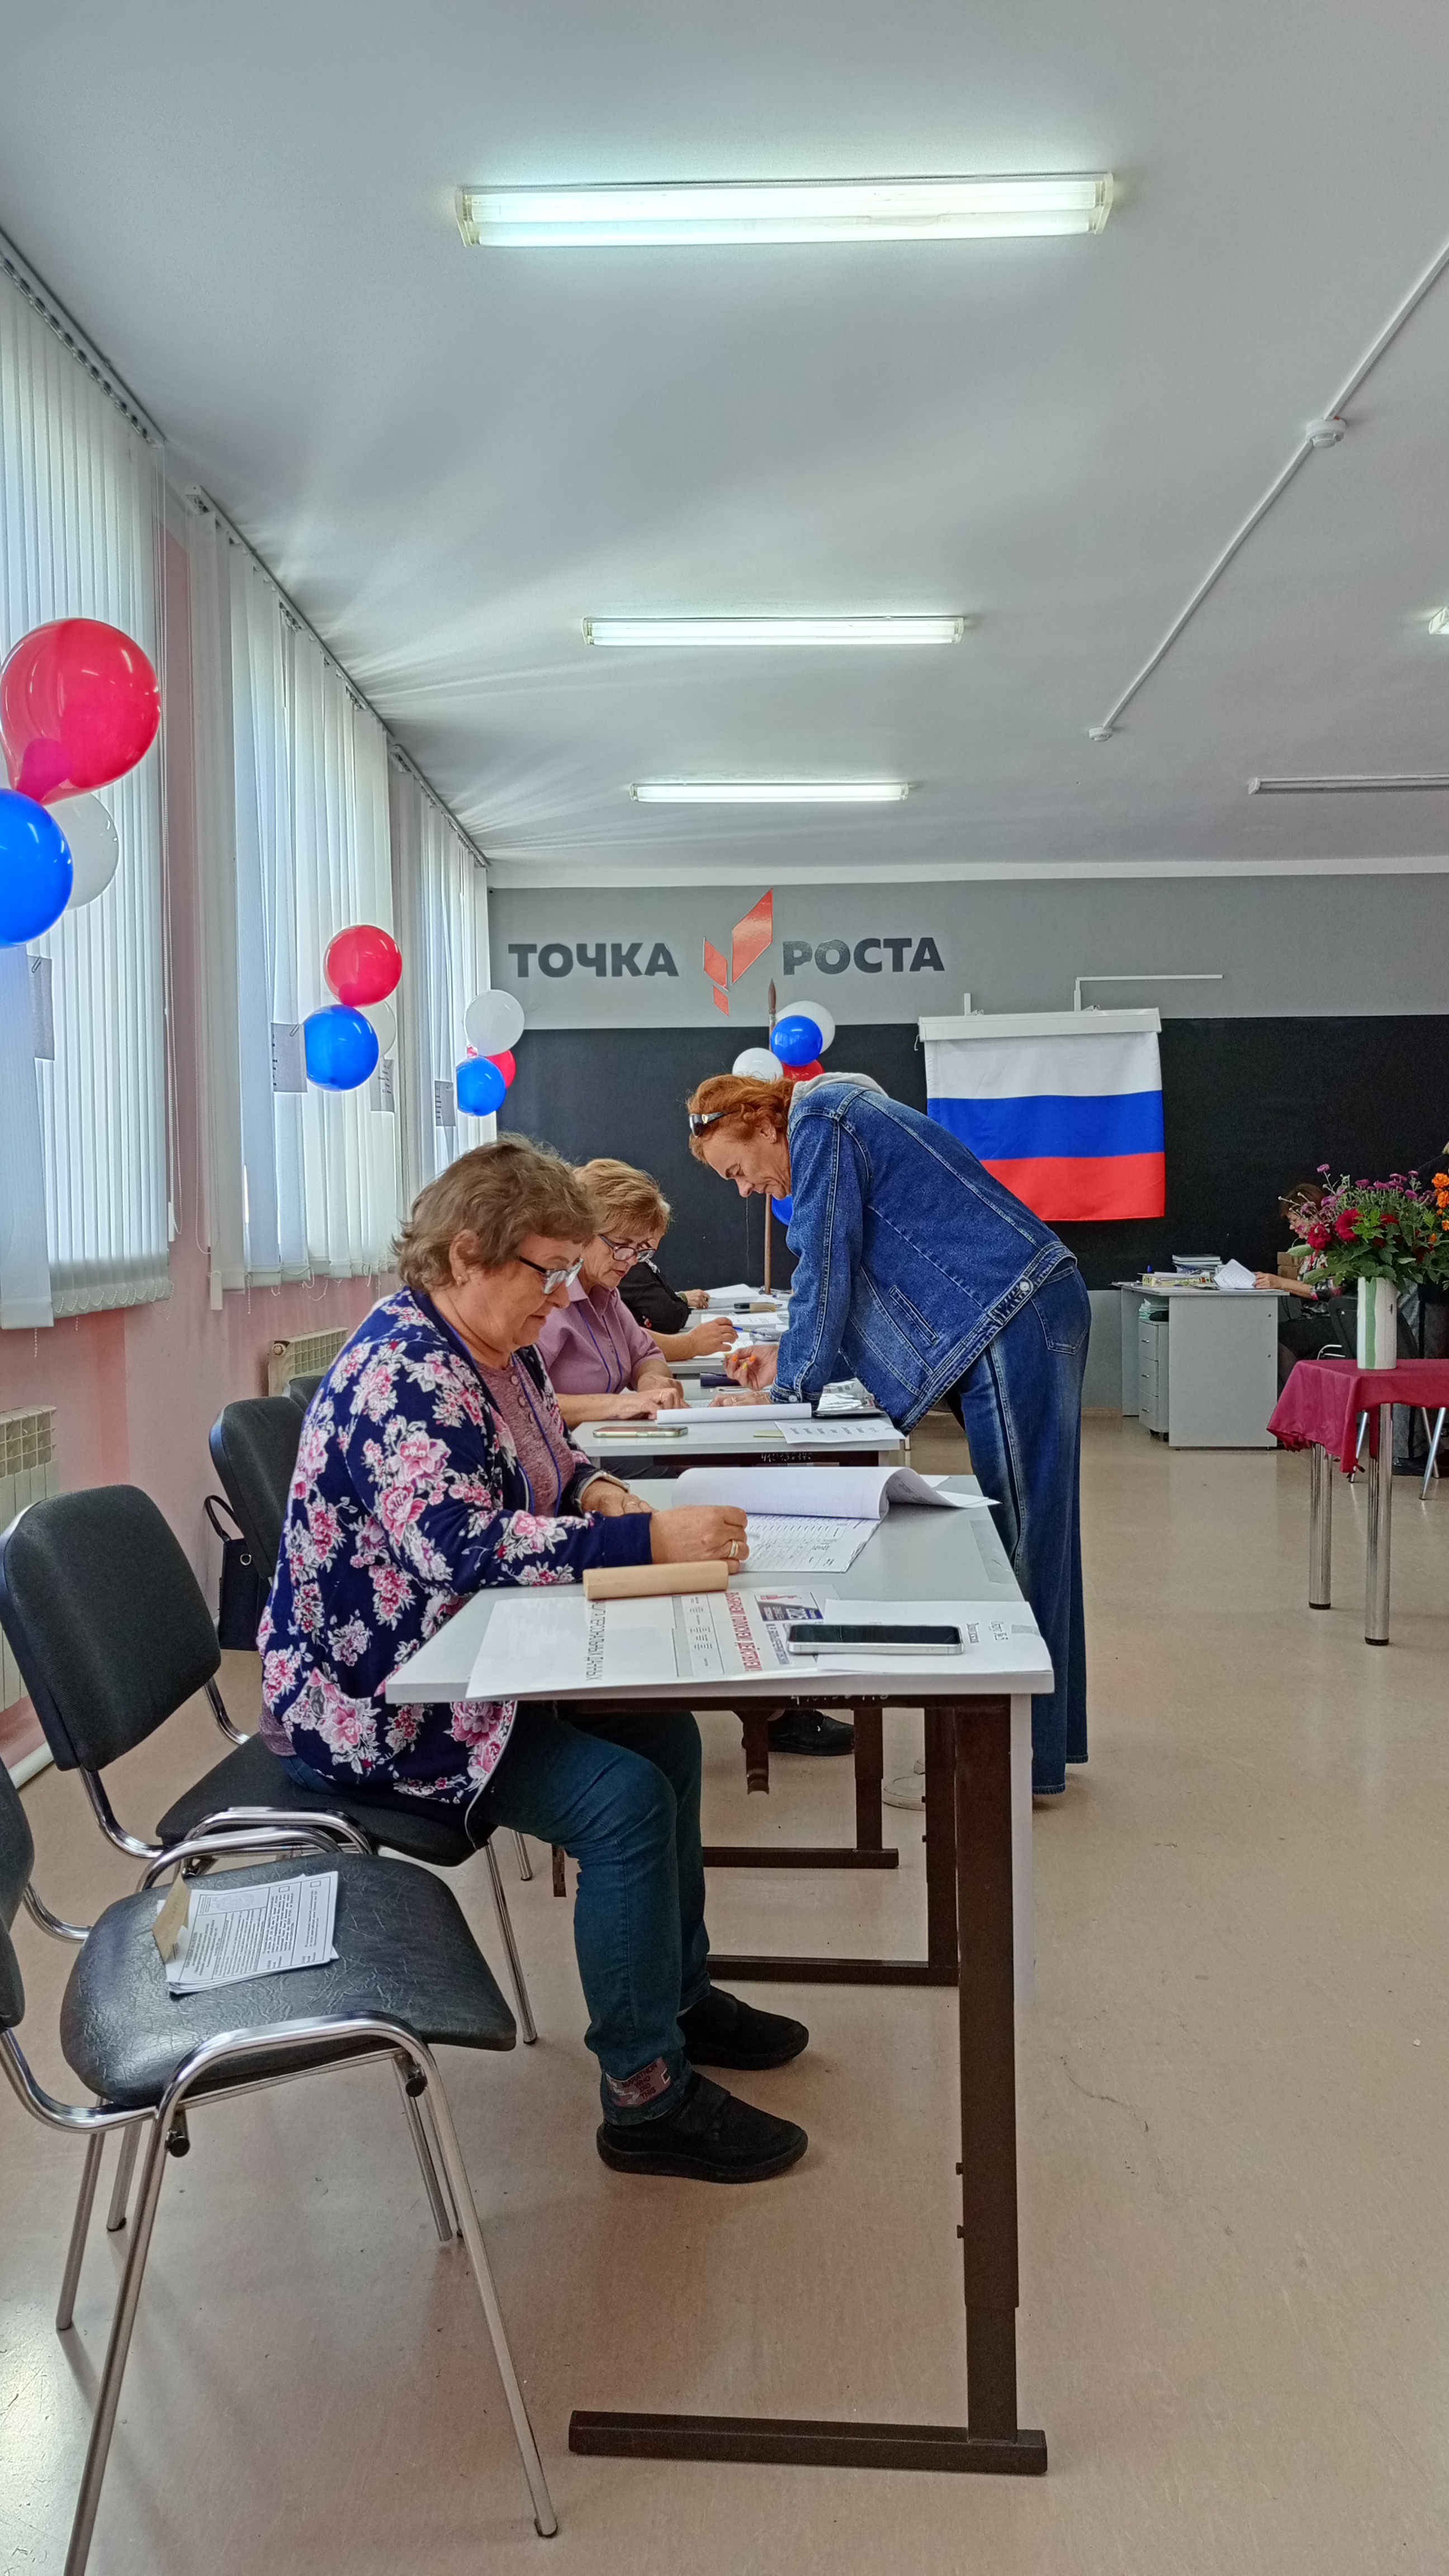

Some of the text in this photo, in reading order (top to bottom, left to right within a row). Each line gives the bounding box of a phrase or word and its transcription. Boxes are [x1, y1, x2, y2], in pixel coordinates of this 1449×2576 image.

[508, 937, 946, 978] ТОЧКА РОСТА
[622, 2062, 658, 2087] MARATHON
[634, 2076, 651, 2088] WHO
[640, 2087, 656, 2099] THIS
